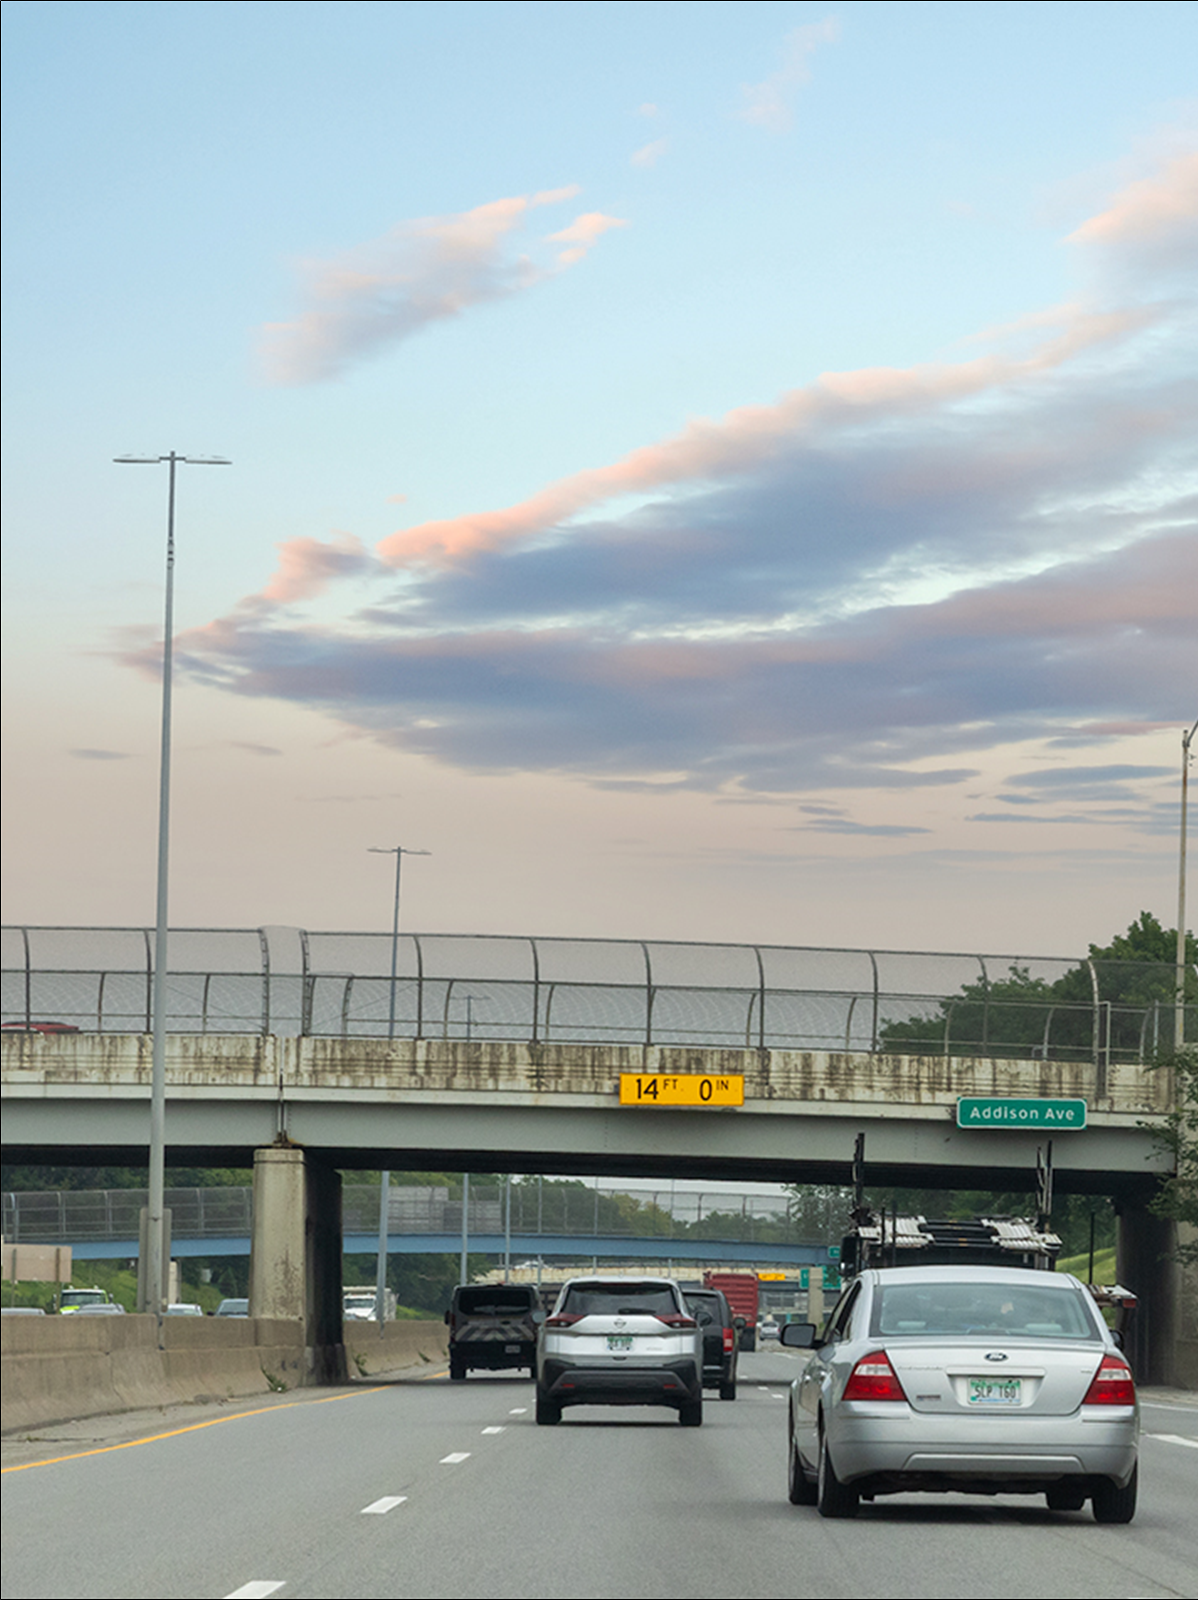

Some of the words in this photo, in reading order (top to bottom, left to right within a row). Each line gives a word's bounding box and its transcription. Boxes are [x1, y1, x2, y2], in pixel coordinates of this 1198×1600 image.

[636, 1078, 659, 1100] 14
[662, 1078, 679, 1091] FT
[699, 1079, 713, 1101] 0
[716, 1080, 730, 1091] IN
[969, 1106, 1039, 1119] Addison
[1044, 1107, 1075, 1121] Ave
